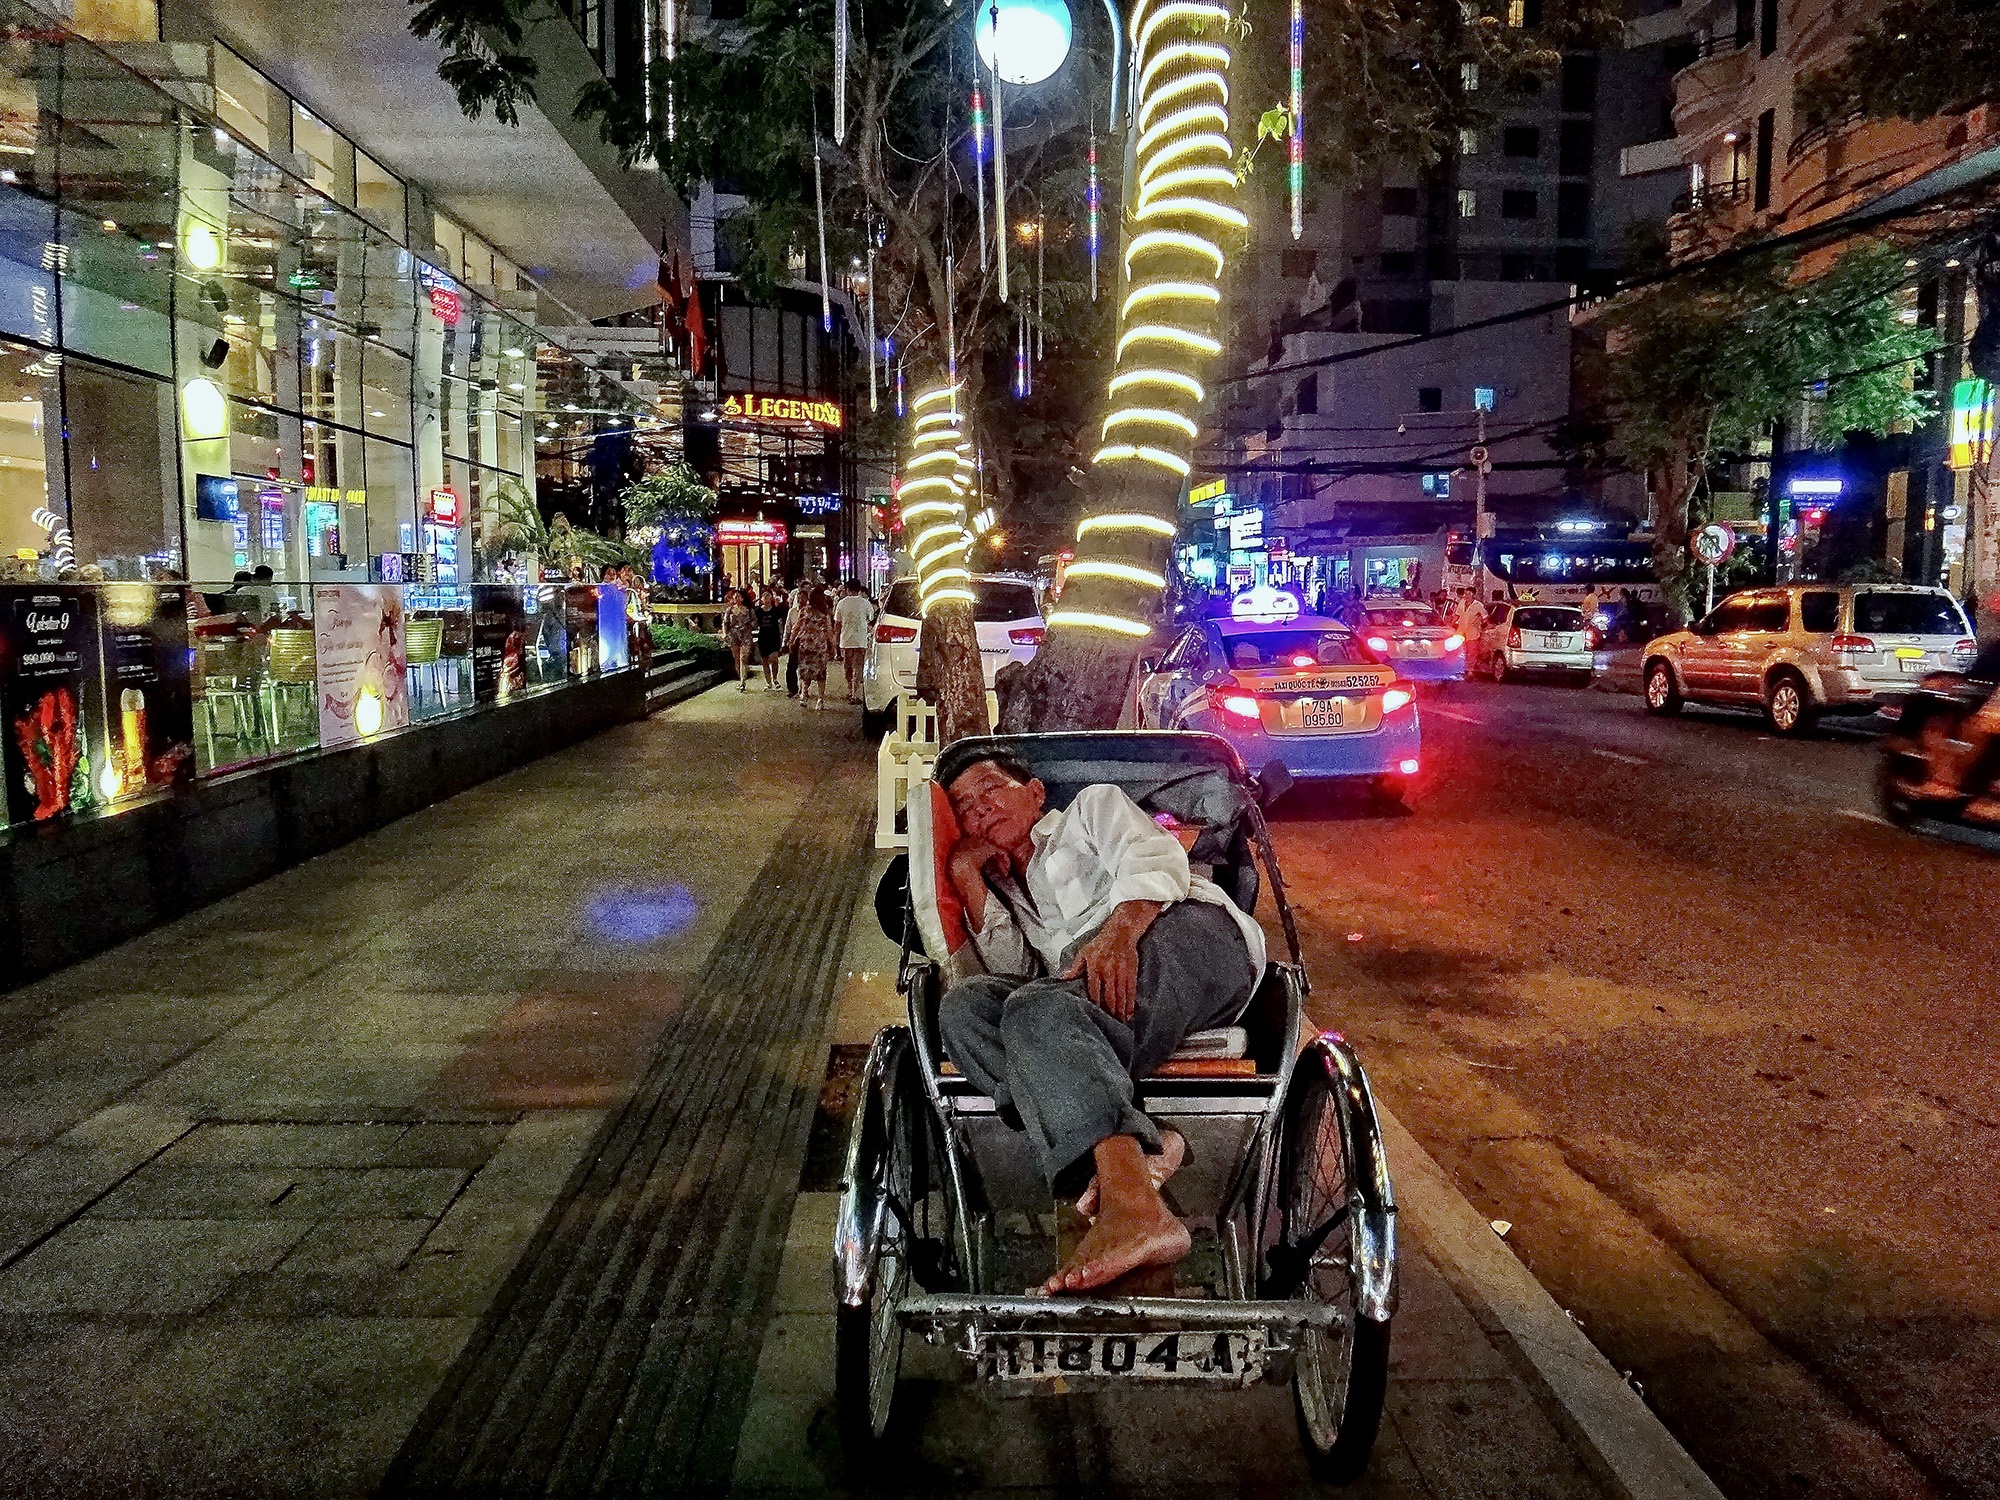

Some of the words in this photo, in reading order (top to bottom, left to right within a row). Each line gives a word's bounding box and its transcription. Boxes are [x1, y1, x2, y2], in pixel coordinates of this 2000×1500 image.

[1274, 681, 1288, 691] TAXI
[1346, 675, 1380, 688] 525252
[1312, 700, 1333, 714] 79A
[1304, 713, 1342, 727] 095.60
